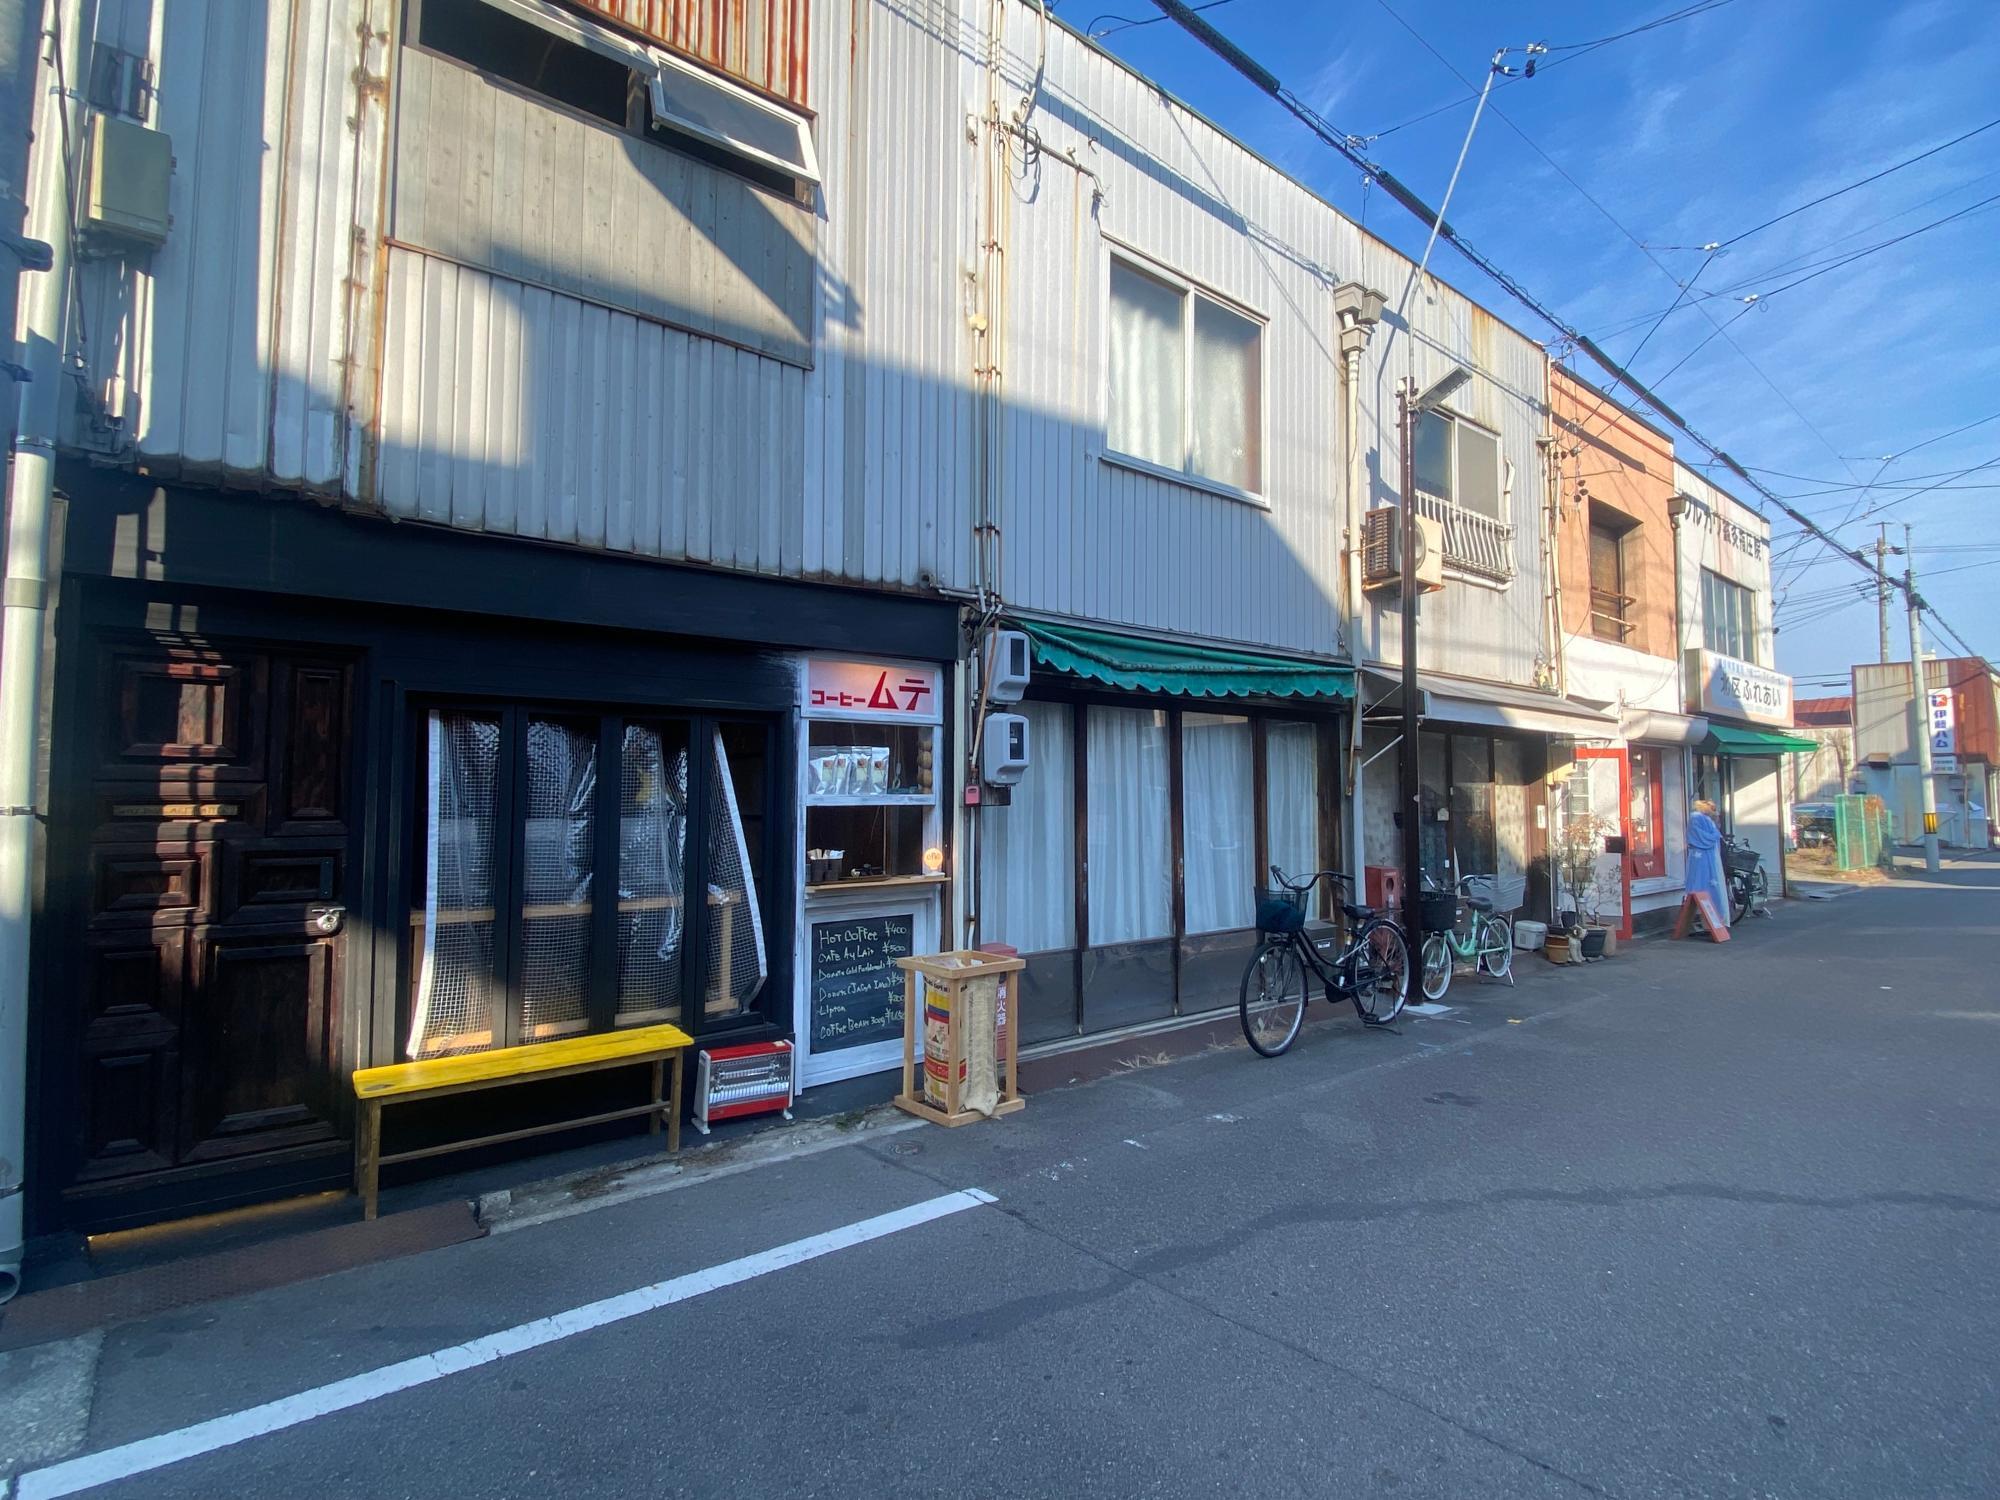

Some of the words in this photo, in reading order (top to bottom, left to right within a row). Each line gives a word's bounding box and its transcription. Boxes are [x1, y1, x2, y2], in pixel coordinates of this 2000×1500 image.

[812, 690, 866, 706] コーヒー
[867, 671, 930, 710] ムテ
[884, 920, 907, 937] ¥400
[996, 985, 1007, 1026] 消火器
